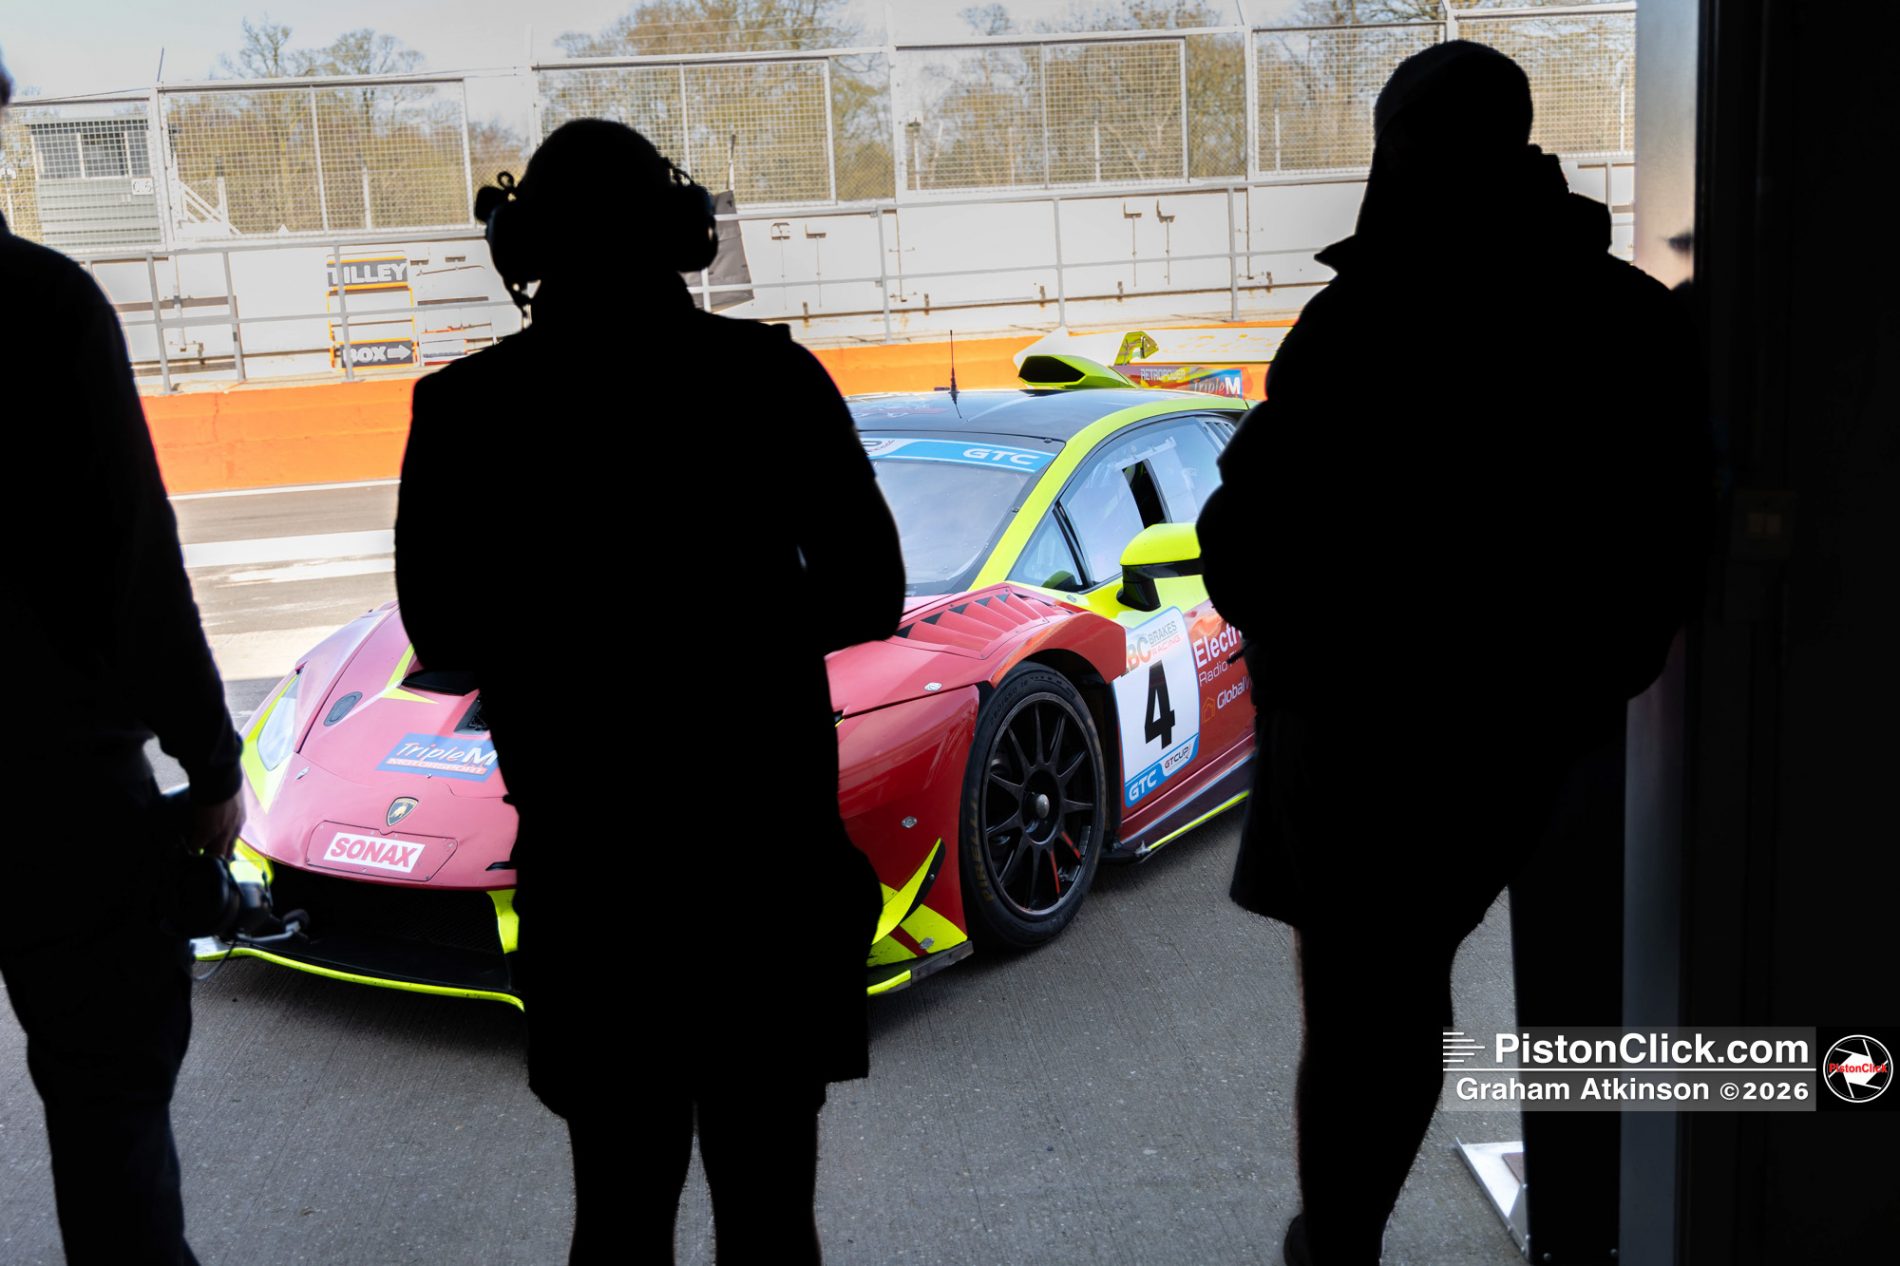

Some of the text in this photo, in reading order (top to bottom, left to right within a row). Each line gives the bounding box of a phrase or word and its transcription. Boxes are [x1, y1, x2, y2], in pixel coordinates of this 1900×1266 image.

[327, 263, 408, 285] TILLEY
[963, 448, 1040, 465] GTC
[1125, 620, 1178, 673] BC BRAKES
[1199, 660, 1228, 686] Radio
[1144, 660, 1175, 750] 4
[396, 742, 499, 766] TripleM
[1129, 769, 1157, 801] GTC
[330, 837, 417, 868] SONAX
